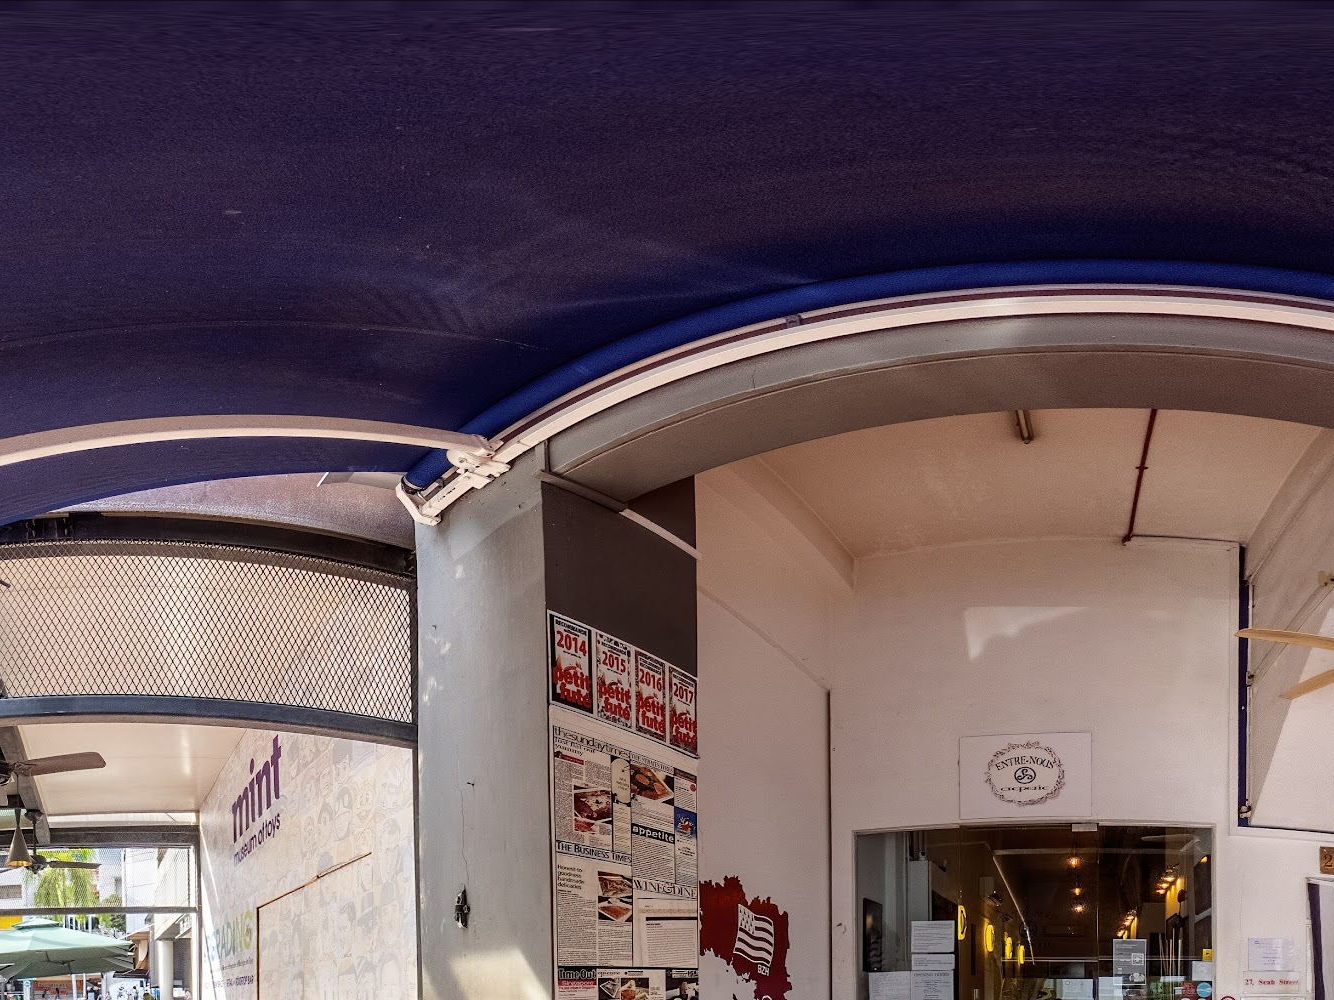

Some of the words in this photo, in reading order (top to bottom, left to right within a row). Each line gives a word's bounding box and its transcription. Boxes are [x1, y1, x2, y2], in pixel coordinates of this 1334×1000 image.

[556, 630, 587, 657] 2014
[602, 650, 626, 673] 2015
[553, 664, 591, 693] petit
[639, 668, 662, 692] 2016
[598, 681, 631, 702] petit
[673, 682, 694, 704] 2017
[995, 755, 1055, 771] ENTRE-NOUS
[231, 734, 282, 844] mint
[233, 834, 257, 867] museum
[264, 813, 281, 839] toys
[632, 825, 675, 843] appetite
[557, 841, 572, 851] THE
[574, 843, 609, 859] BUSINESS
[612, 851, 632, 863] TIMES
[559, 968, 580, 980] Time
[580, 968, 596, 979] Out
